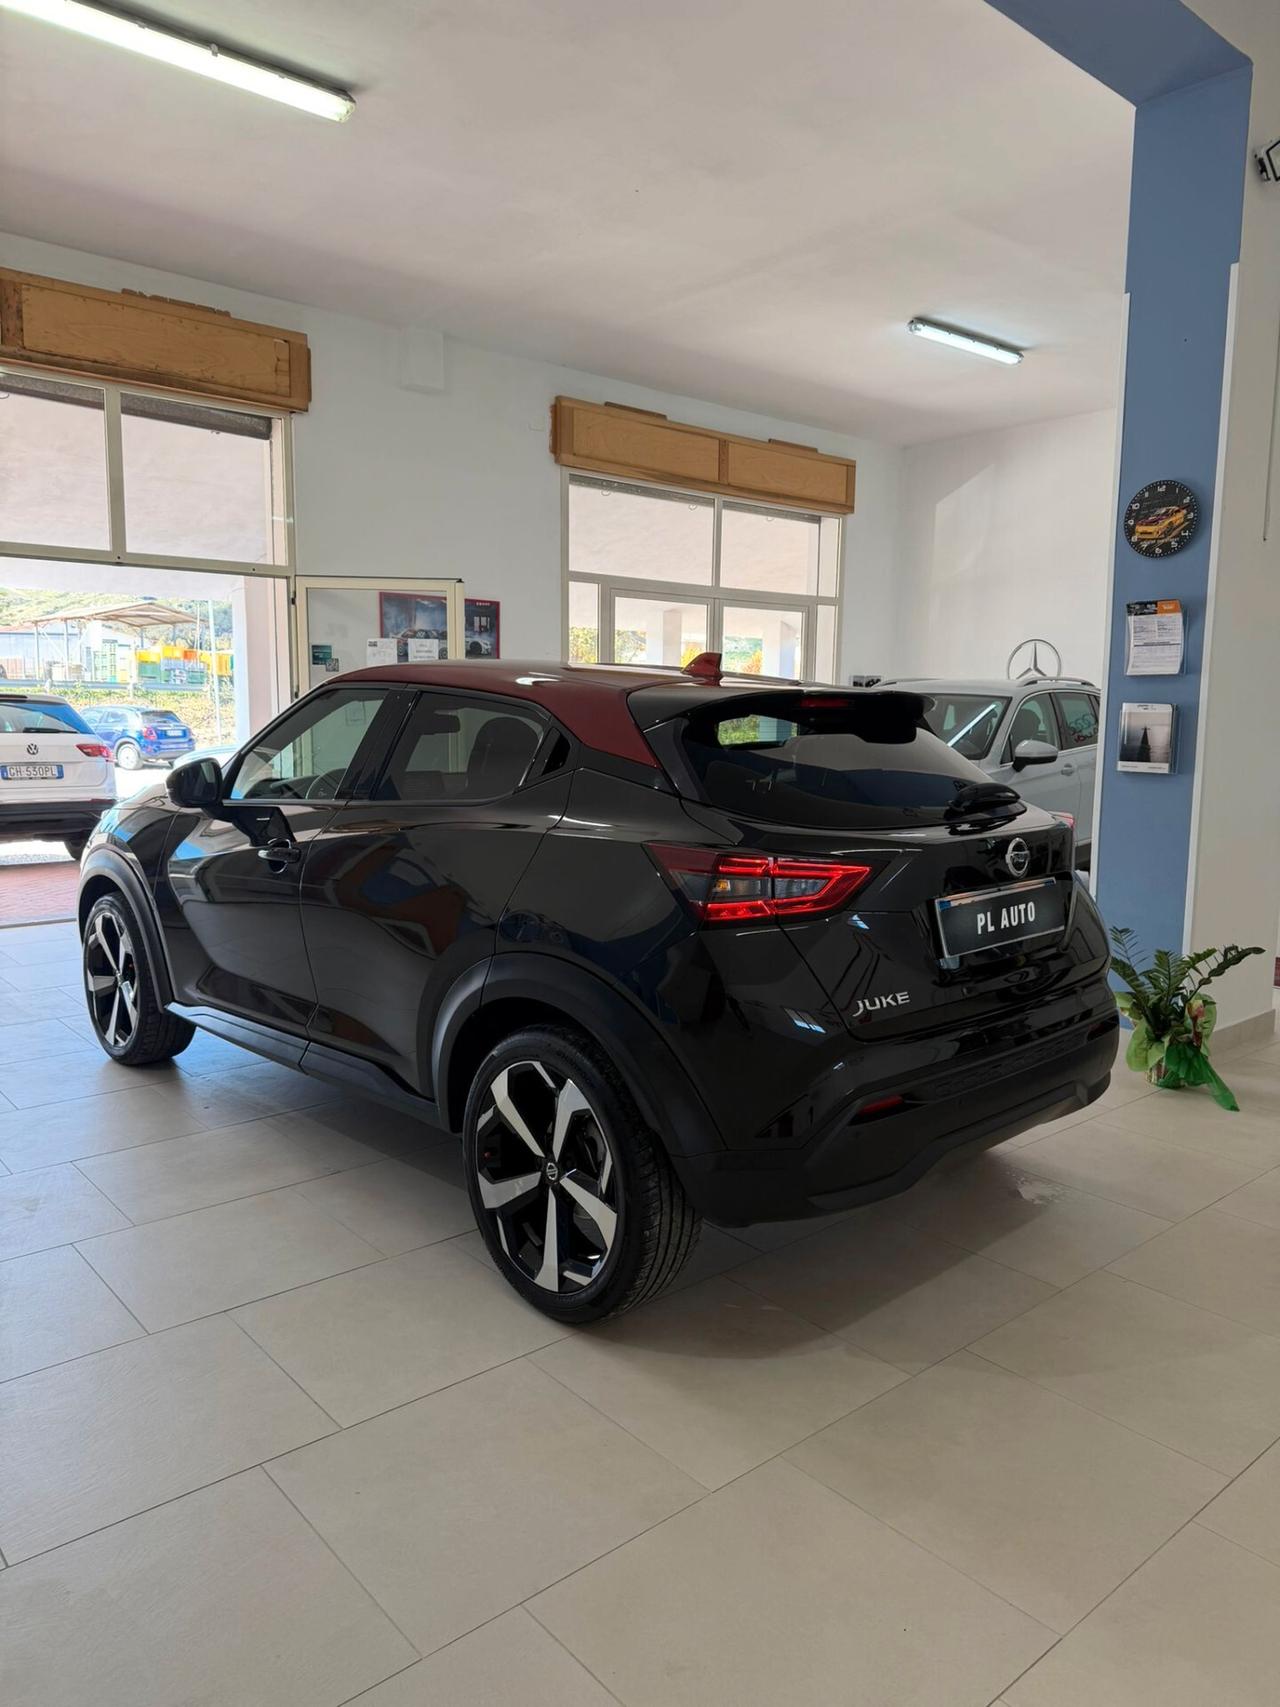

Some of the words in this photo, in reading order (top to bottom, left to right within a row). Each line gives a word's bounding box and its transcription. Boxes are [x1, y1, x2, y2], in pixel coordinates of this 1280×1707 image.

[976, 911, 995, 935] PL
[1000, 901, 1036, 929] AUTO
[851, 991, 911, 1017] JUKE
